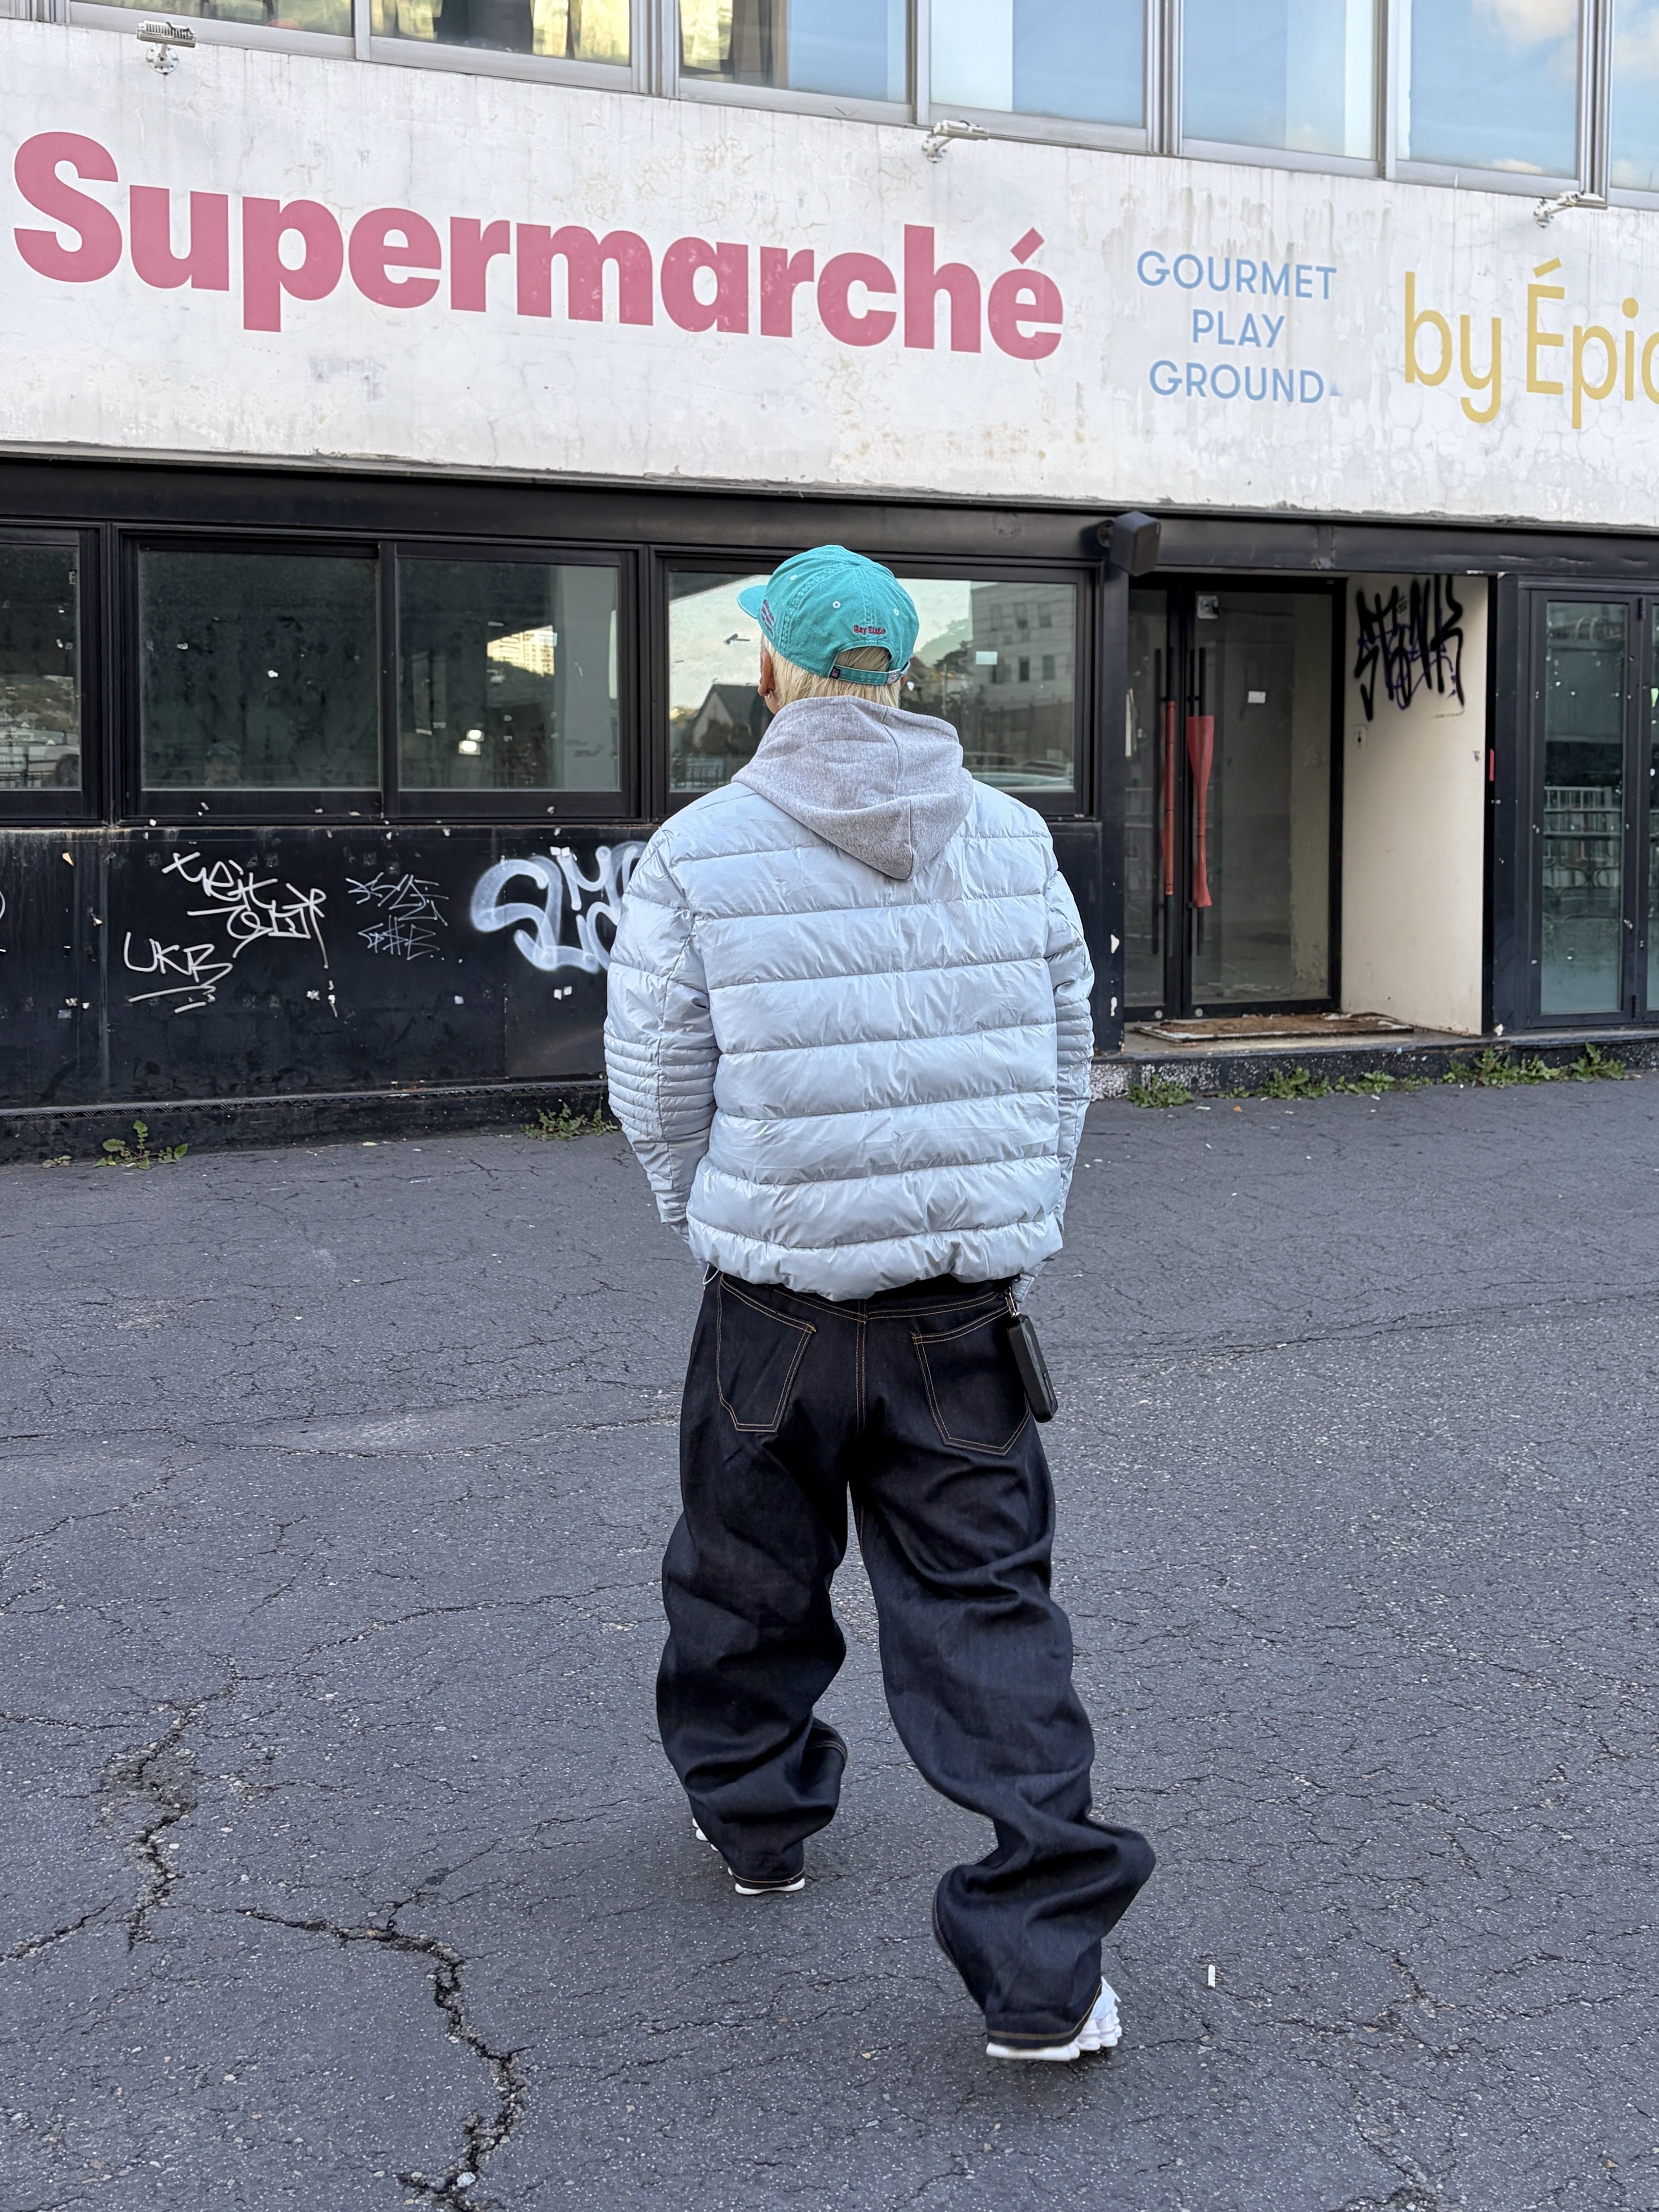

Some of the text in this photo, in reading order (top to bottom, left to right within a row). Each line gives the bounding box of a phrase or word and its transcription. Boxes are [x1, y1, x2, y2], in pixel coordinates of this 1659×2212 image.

[14, 131, 1063, 359] Supermarché
[1137, 251, 1336, 300] GOURMET
[1192, 309, 1285, 348] PLAY
[1405, 271, 1502, 423] by
[1149, 360, 1325, 404] GROUND
